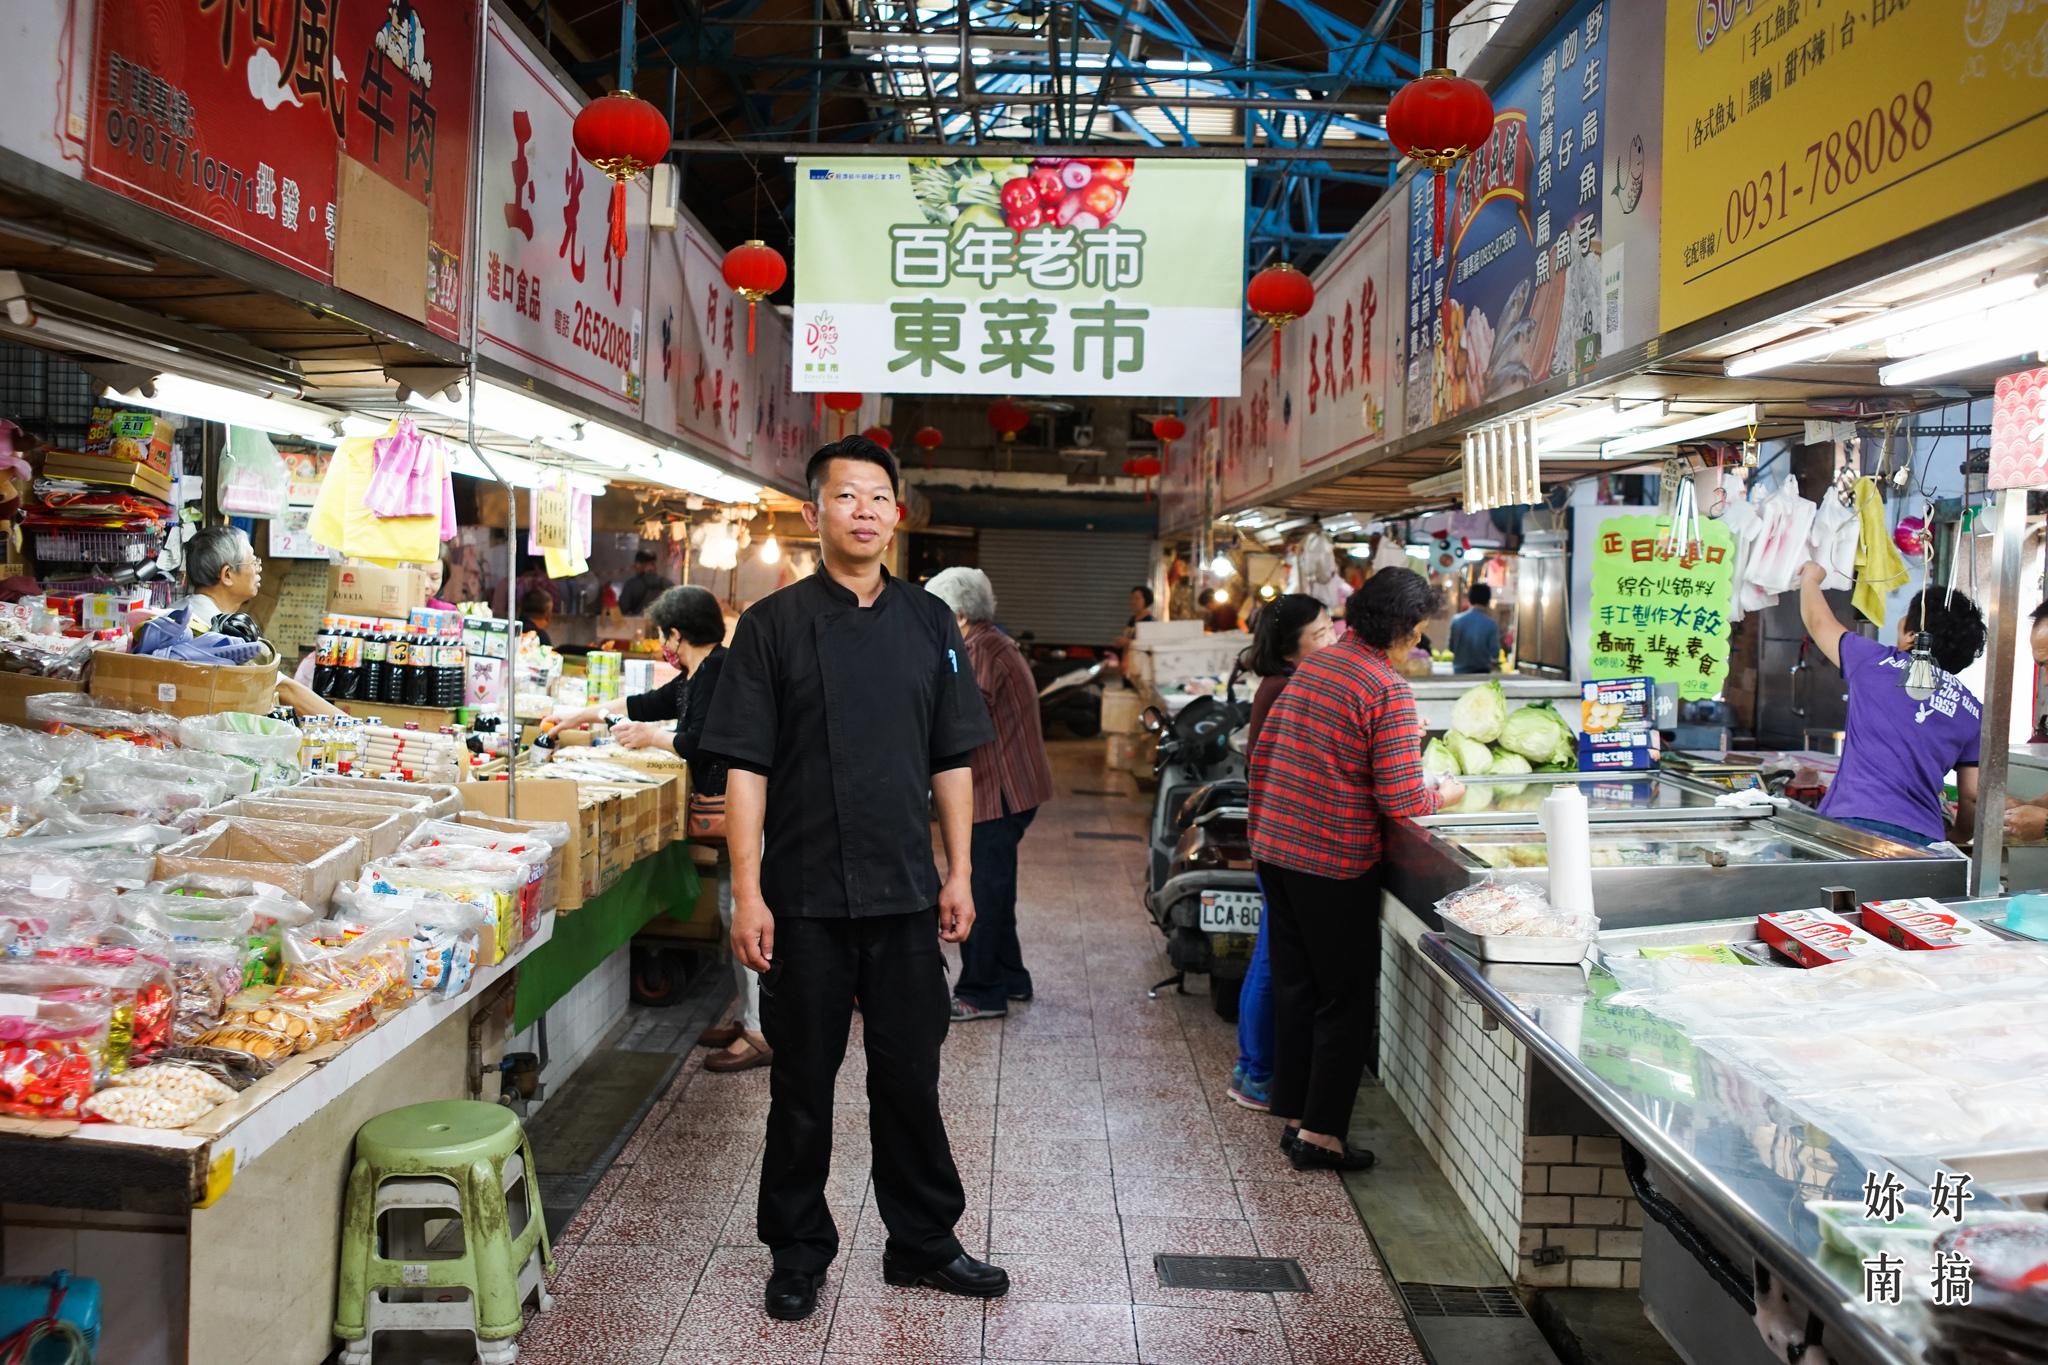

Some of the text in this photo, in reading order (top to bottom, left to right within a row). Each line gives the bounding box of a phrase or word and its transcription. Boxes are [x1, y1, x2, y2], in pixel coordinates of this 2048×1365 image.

[358, 48, 438, 195] 牛肉
[1694, 94, 1736, 149] 各式魚丸
[1747, 67, 1772, 114] 黑輪
[1784, 28, 1826, 88] 甜不辣
[106, 108, 254, 213] 0987710771
[1556, 28, 1579, 272] 吻仔魚
[1578, 1, 1604, 256] 野生烏魚子
[1726, 80, 1934, 245] 0931-788088
[487, 250, 541, 322] 進口食品
[888, 222, 1146, 292] 百年老市
[554, 308, 570, 339] 電話
[572, 300, 632, 372] 2652089
[887, 298, 1150, 380] 東菜市
[1583, 309, 1593, 334] 49
[1600, 602, 1722, 637] 手工製作水餃
[1616, 576, 1716, 598] 綜合火鍋料
[1929, 693, 1957, 715] 1953
[1203, 904, 1262, 927] LCA-80
